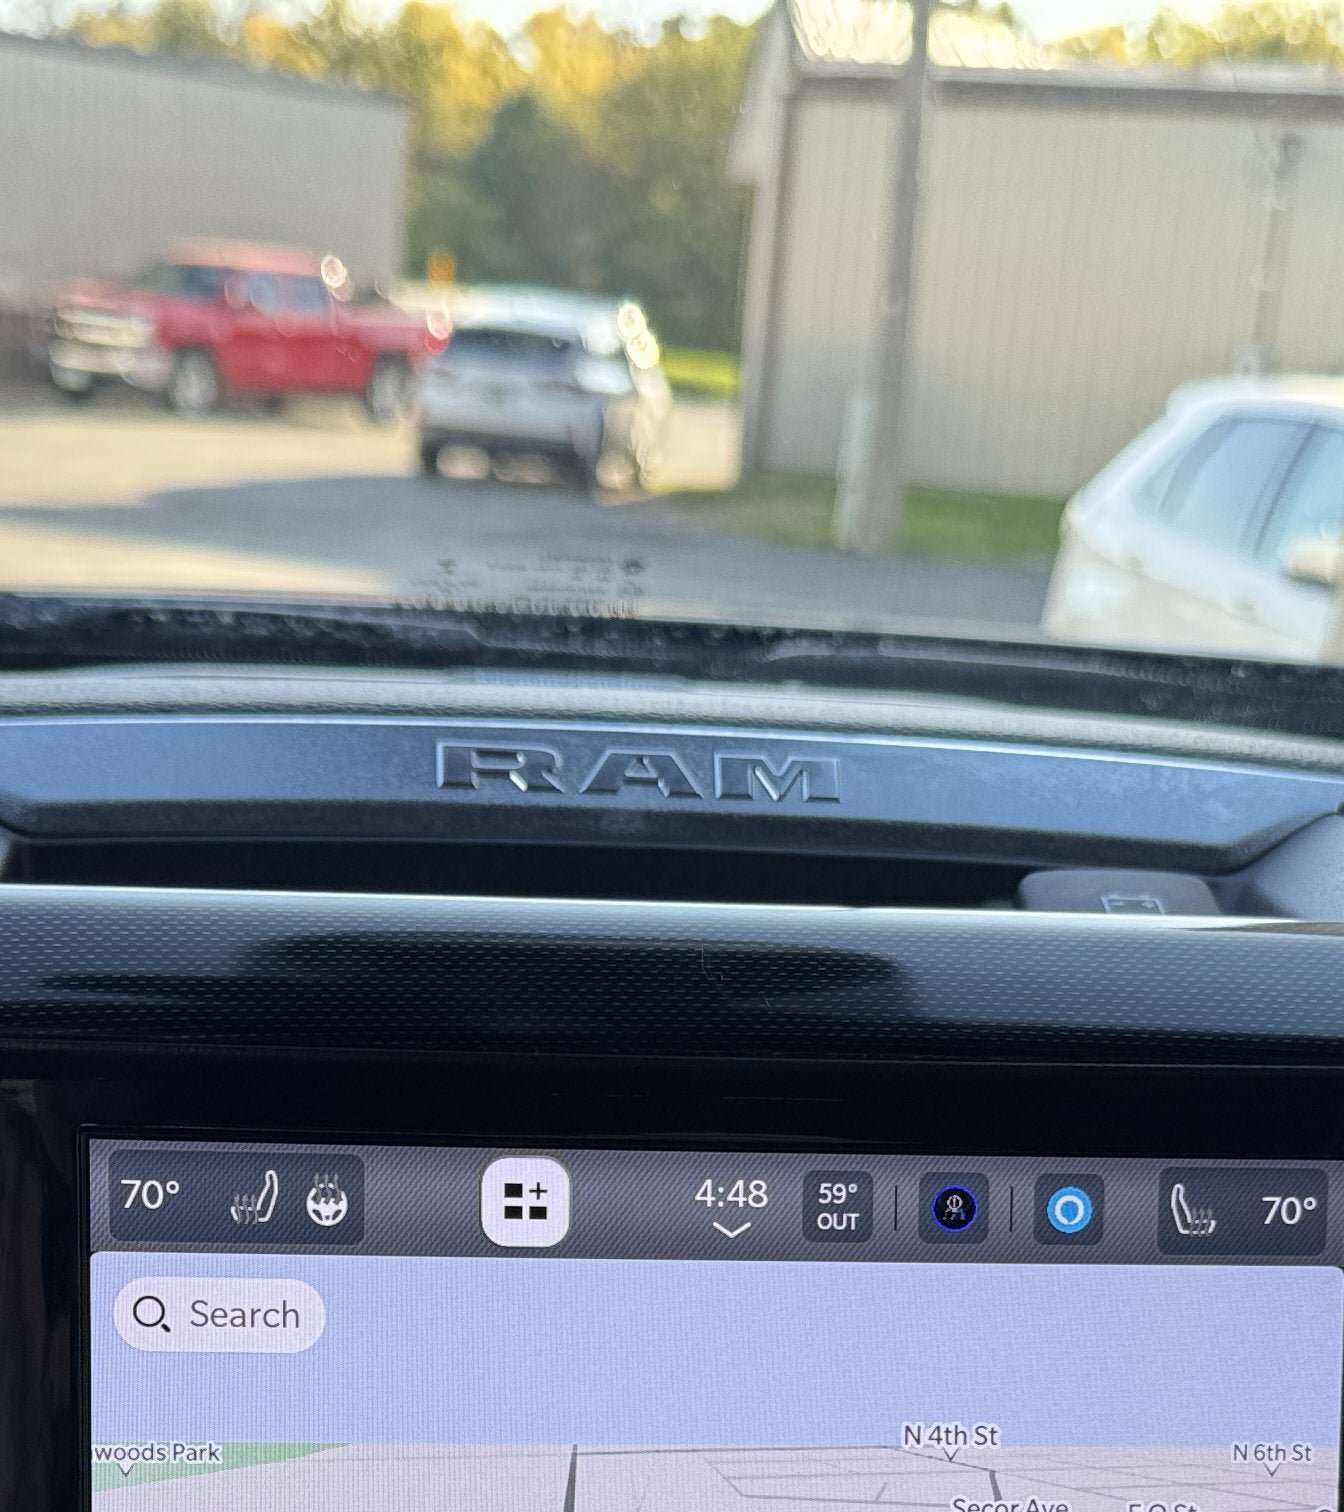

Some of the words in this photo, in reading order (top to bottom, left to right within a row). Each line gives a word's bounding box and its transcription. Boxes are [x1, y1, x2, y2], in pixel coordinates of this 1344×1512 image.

[436, 738, 842, 804] RAM
[121, 1180, 179, 1209] 70°
[695, 1179, 768, 1207] 4:48
[819, 1183, 857, 1204] 59°
[817, 1213, 859, 1230] OUT
[1262, 1197, 1317, 1224] 70°
[191, 1300, 299, 1328] Search
[905, 1425, 921, 1445] N
[928, 1425, 968, 1446] 4th
[974, 1425, 998, 1446] St
[95, 1443, 166, 1461] woods
[173, 1443, 219, 1461] Park
[1234, 1444, 1247, 1460] N
[1254, 1443, 1286, 1461] 6th
[1291, 1443, 1312, 1461] St
